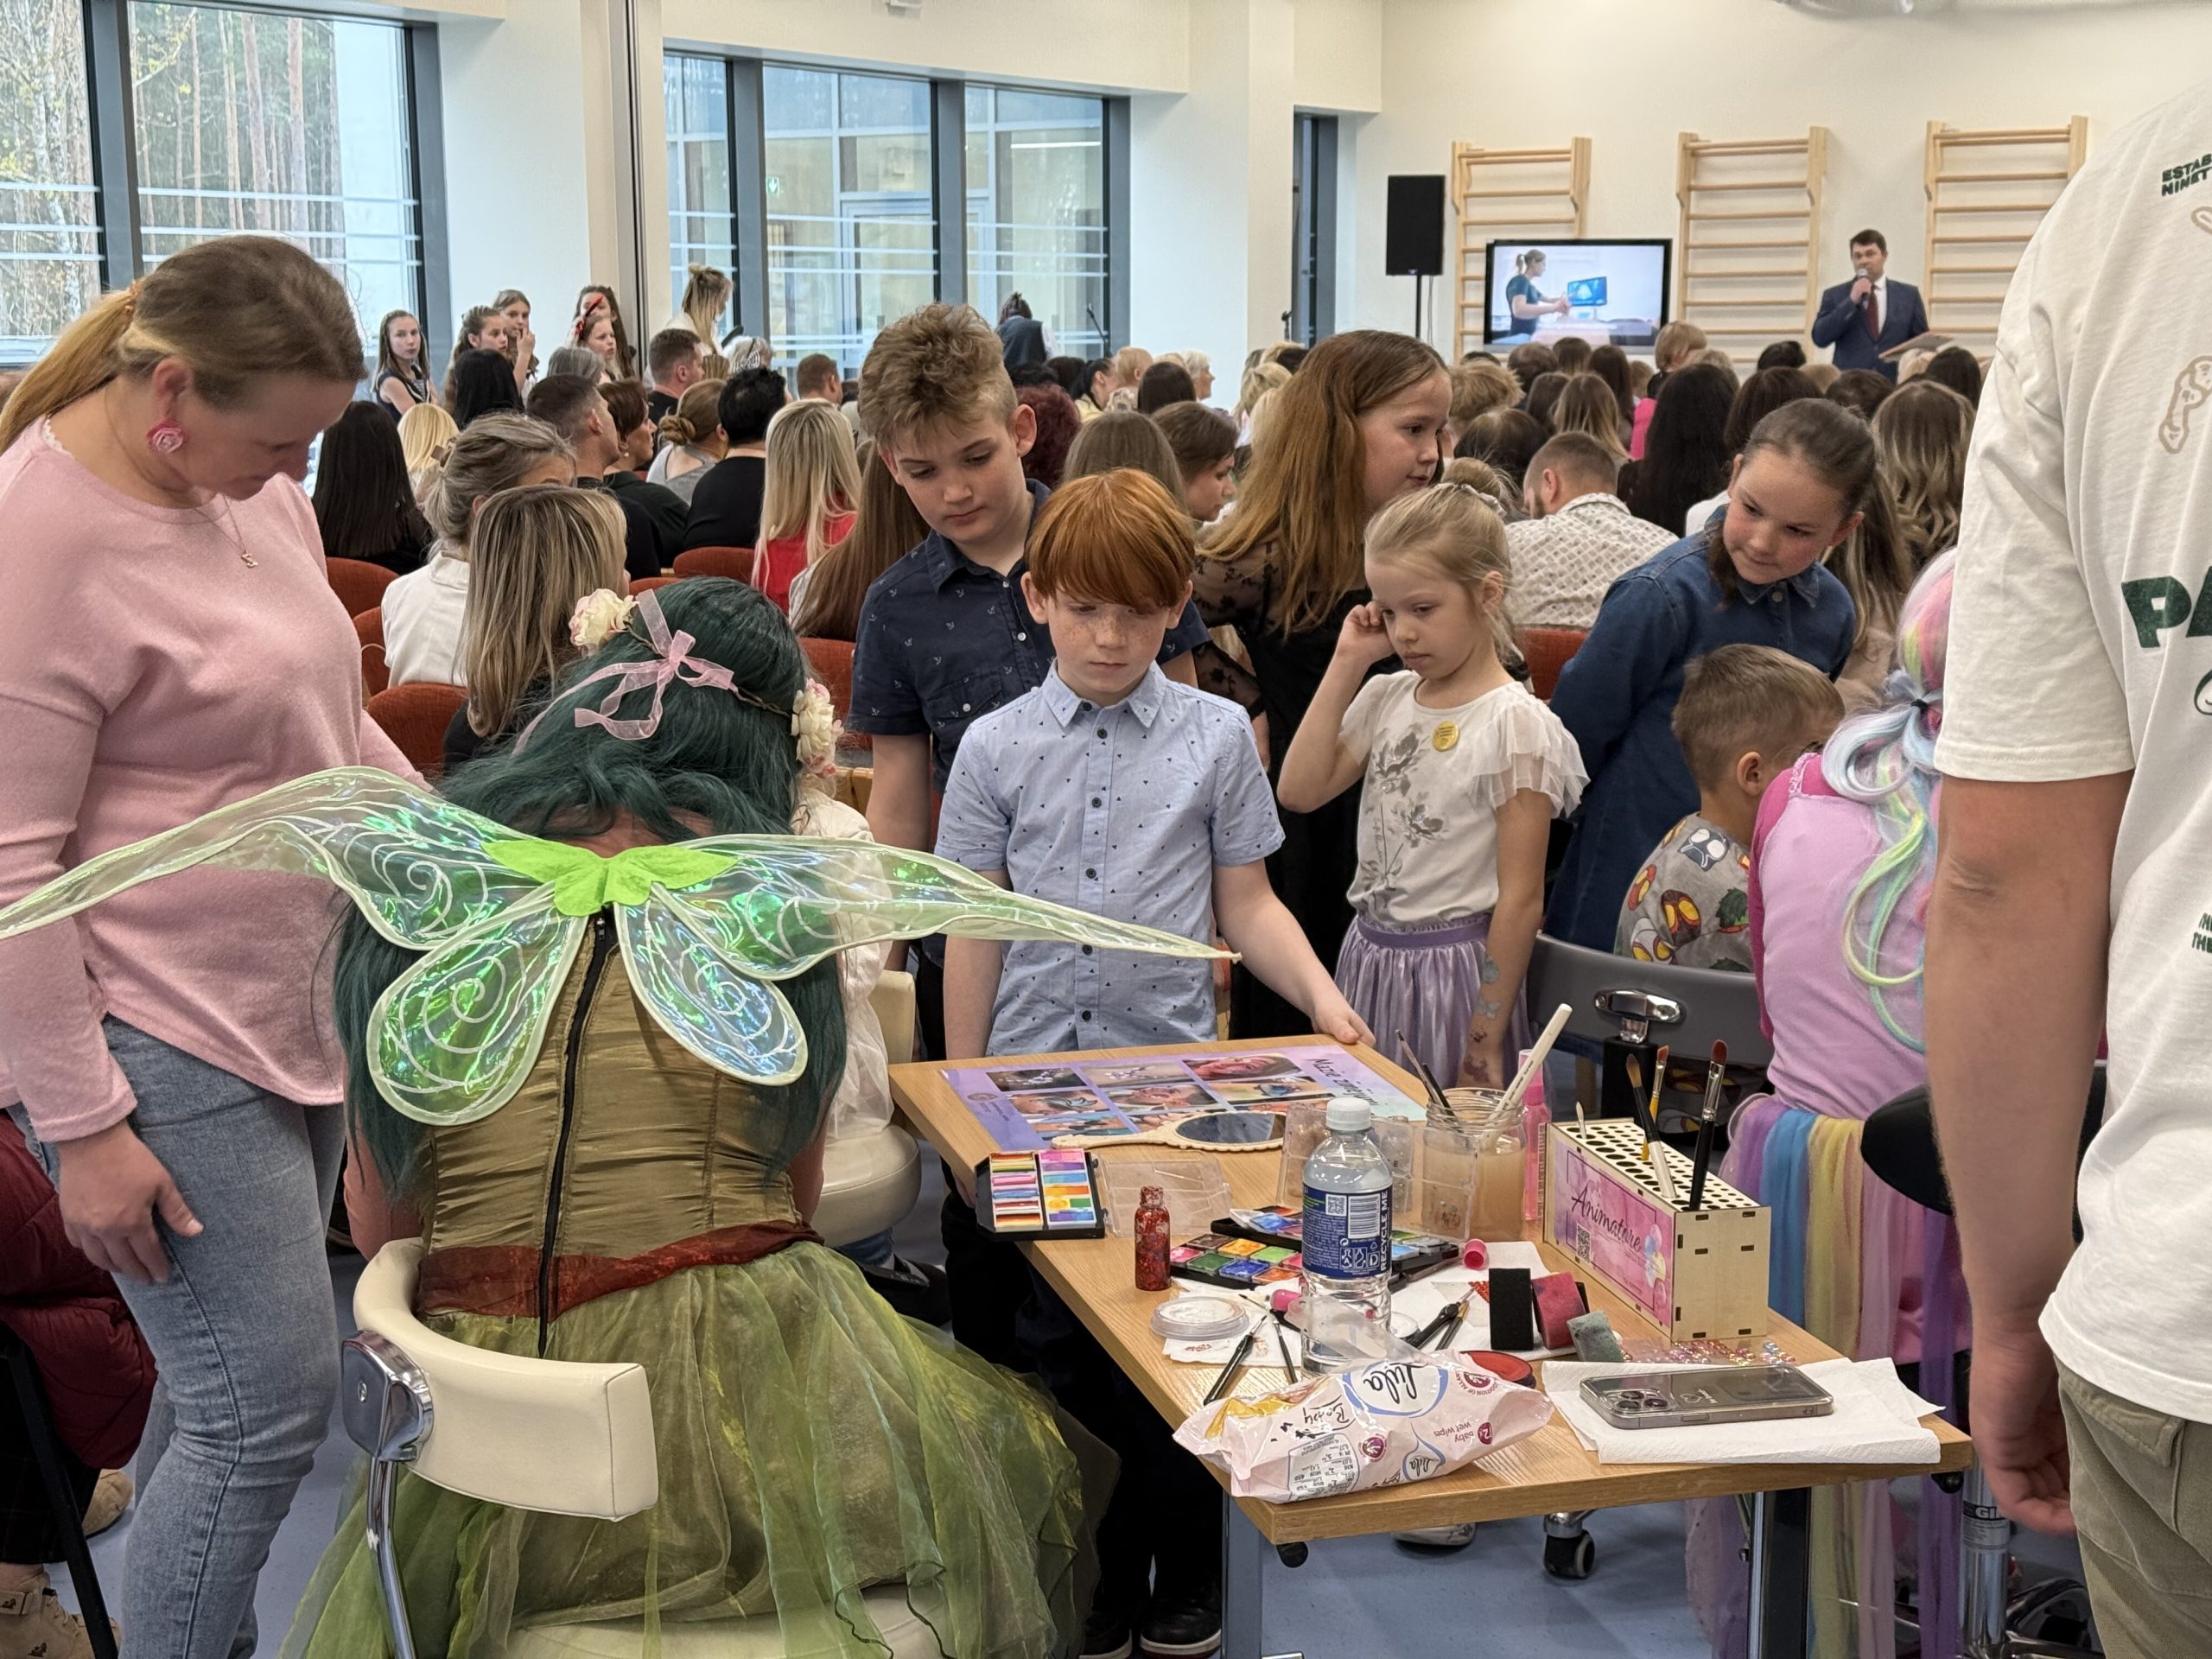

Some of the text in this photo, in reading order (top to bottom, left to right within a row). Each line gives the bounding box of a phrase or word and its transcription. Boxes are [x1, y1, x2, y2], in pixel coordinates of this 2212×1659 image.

[2162, 154, 2212, 182] ESTAB
[1382, 1190, 1388, 1211] ME
[1571, 1184, 1641, 1252] Animatore
[1433, 1421, 1471, 1437] wet wipes
[1455, 1431, 1474, 1443] baby
[1975, 1506, 2000, 1519] GI
